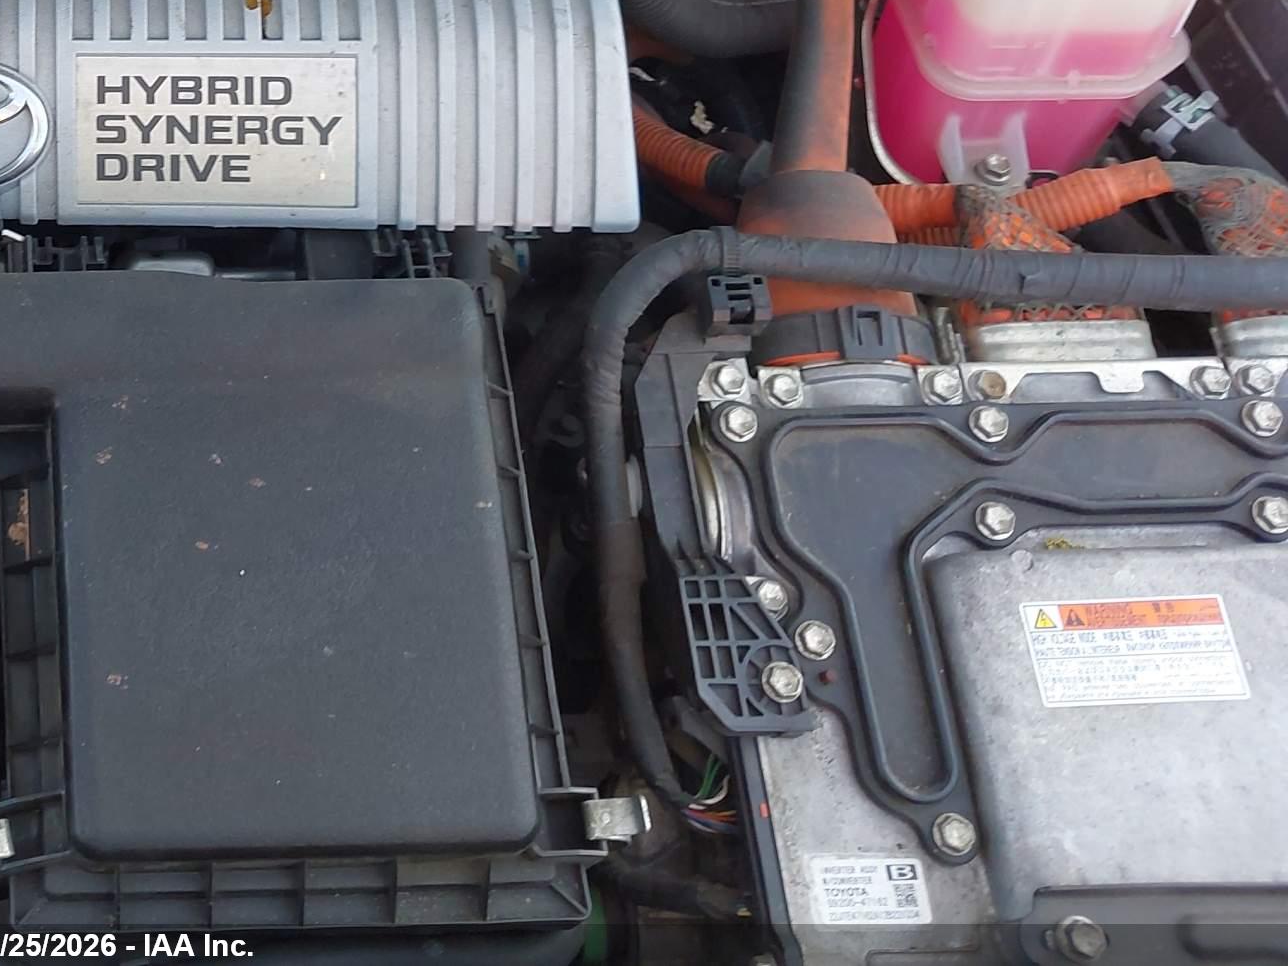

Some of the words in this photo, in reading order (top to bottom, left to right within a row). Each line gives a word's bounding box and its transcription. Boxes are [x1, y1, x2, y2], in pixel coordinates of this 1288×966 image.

[97, 76, 292, 105] HYBRID
[96, 115, 343, 145] SYNERGY
[96, 154, 251, 182] DRIVE
[889, 864, 915, 881] B
[824, 887, 868, 897] TOYOTA
